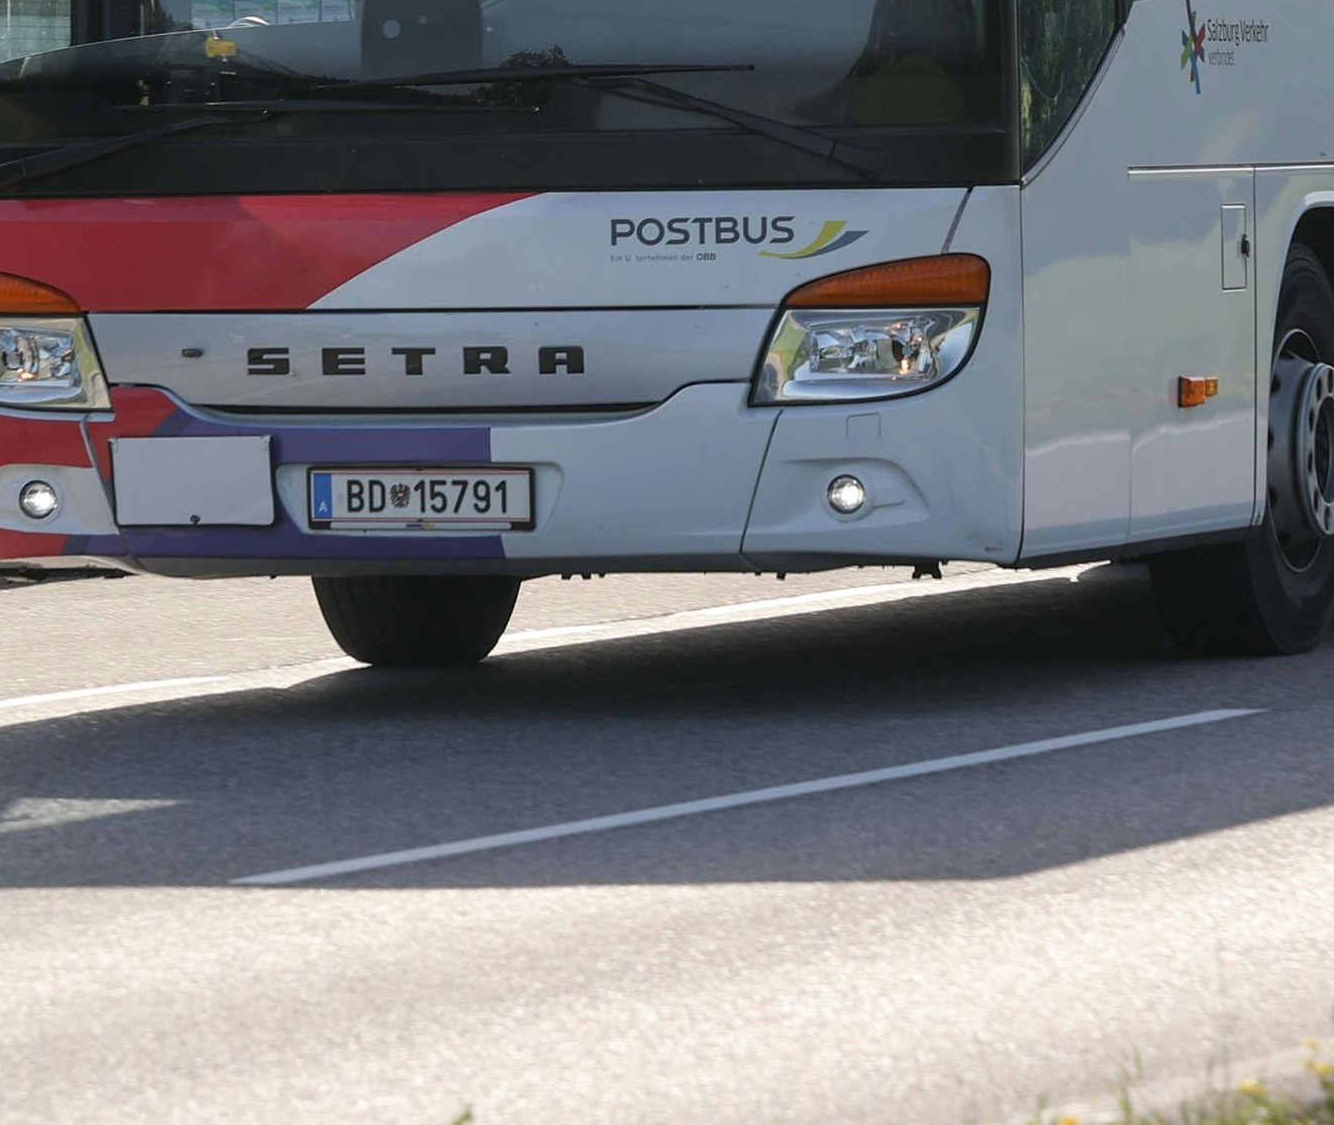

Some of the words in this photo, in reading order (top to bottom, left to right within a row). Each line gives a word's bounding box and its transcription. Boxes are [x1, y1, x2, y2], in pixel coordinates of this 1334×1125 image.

[1207, 18, 1240, 46] Salzburg
[1240, 19, 1269, 43] Verkehr
[610, 215, 796, 246] POSTBUS
[610, 254, 623, 263] Ein
[680, 253, 694, 262] der
[247, 346, 585, 376] SETRA
[318, 501, 329, 513] A
[346, 479, 386, 513] BD
[413, 479, 507, 514] 15791
